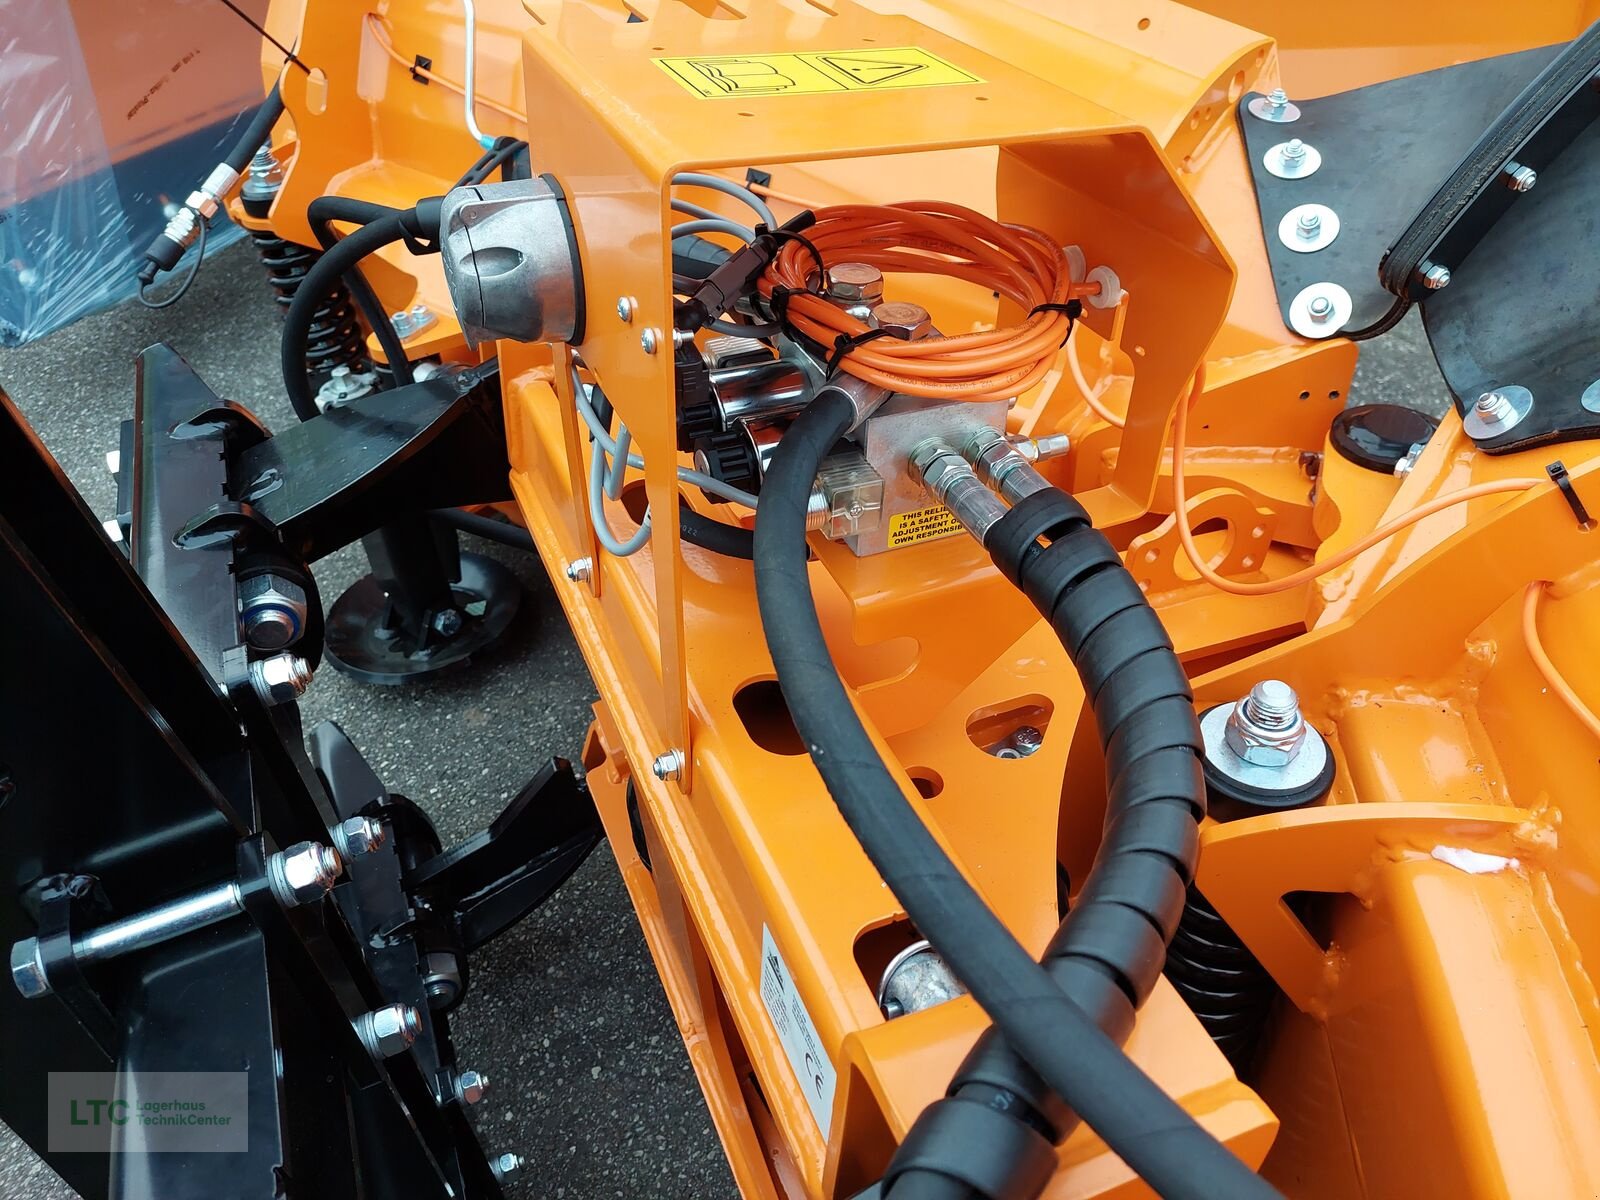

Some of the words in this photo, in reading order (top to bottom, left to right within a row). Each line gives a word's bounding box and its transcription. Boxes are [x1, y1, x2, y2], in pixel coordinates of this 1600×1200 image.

[899, 521, 908, 529] IS
[918, 512, 950, 525] SAFETY
[902, 511, 922, 521] THIS
[892, 520, 949, 538] ADJUSTMENT
[894, 535, 914, 545] OWN
